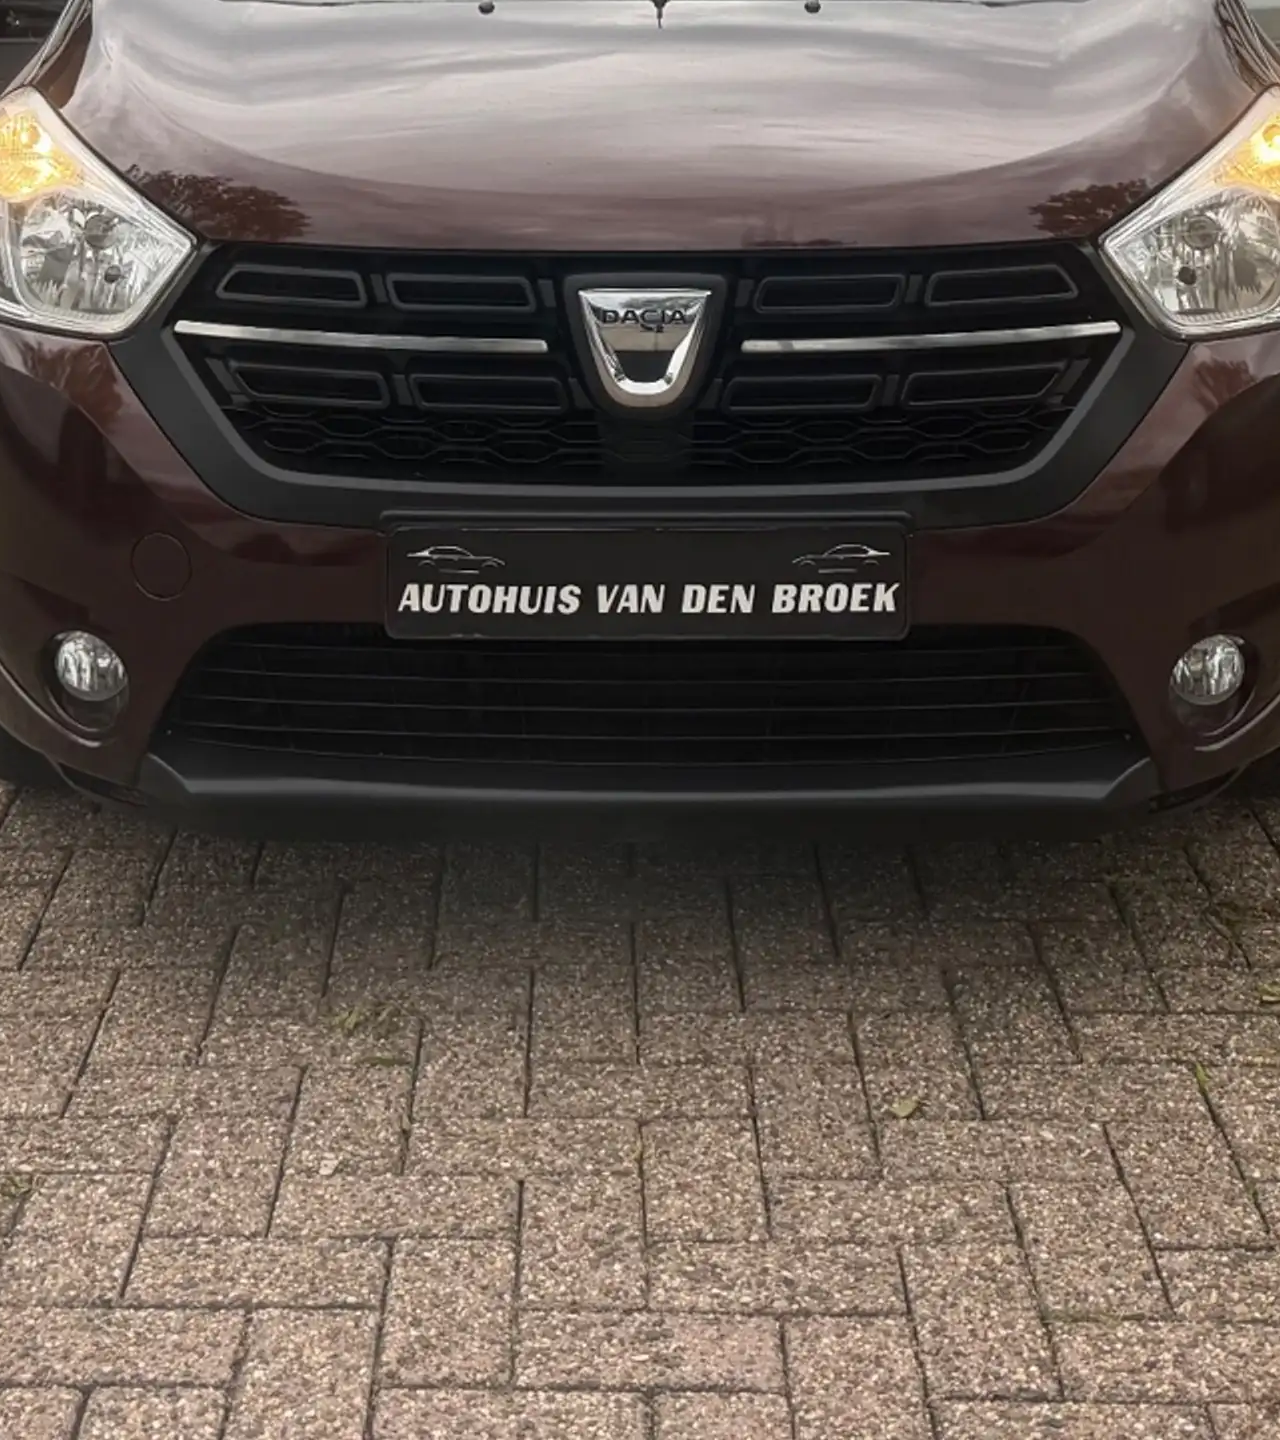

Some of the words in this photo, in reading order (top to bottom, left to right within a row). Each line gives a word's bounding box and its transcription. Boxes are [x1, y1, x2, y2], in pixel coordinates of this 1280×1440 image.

[602, 309, 687, 324] DACIA
[397, 583, 582, 615] AUTOHUIS
[597, 583, 666, 614] VAN
[681, 583, 756, 614] DEN
[771, 582, 901, 614] BROEK
